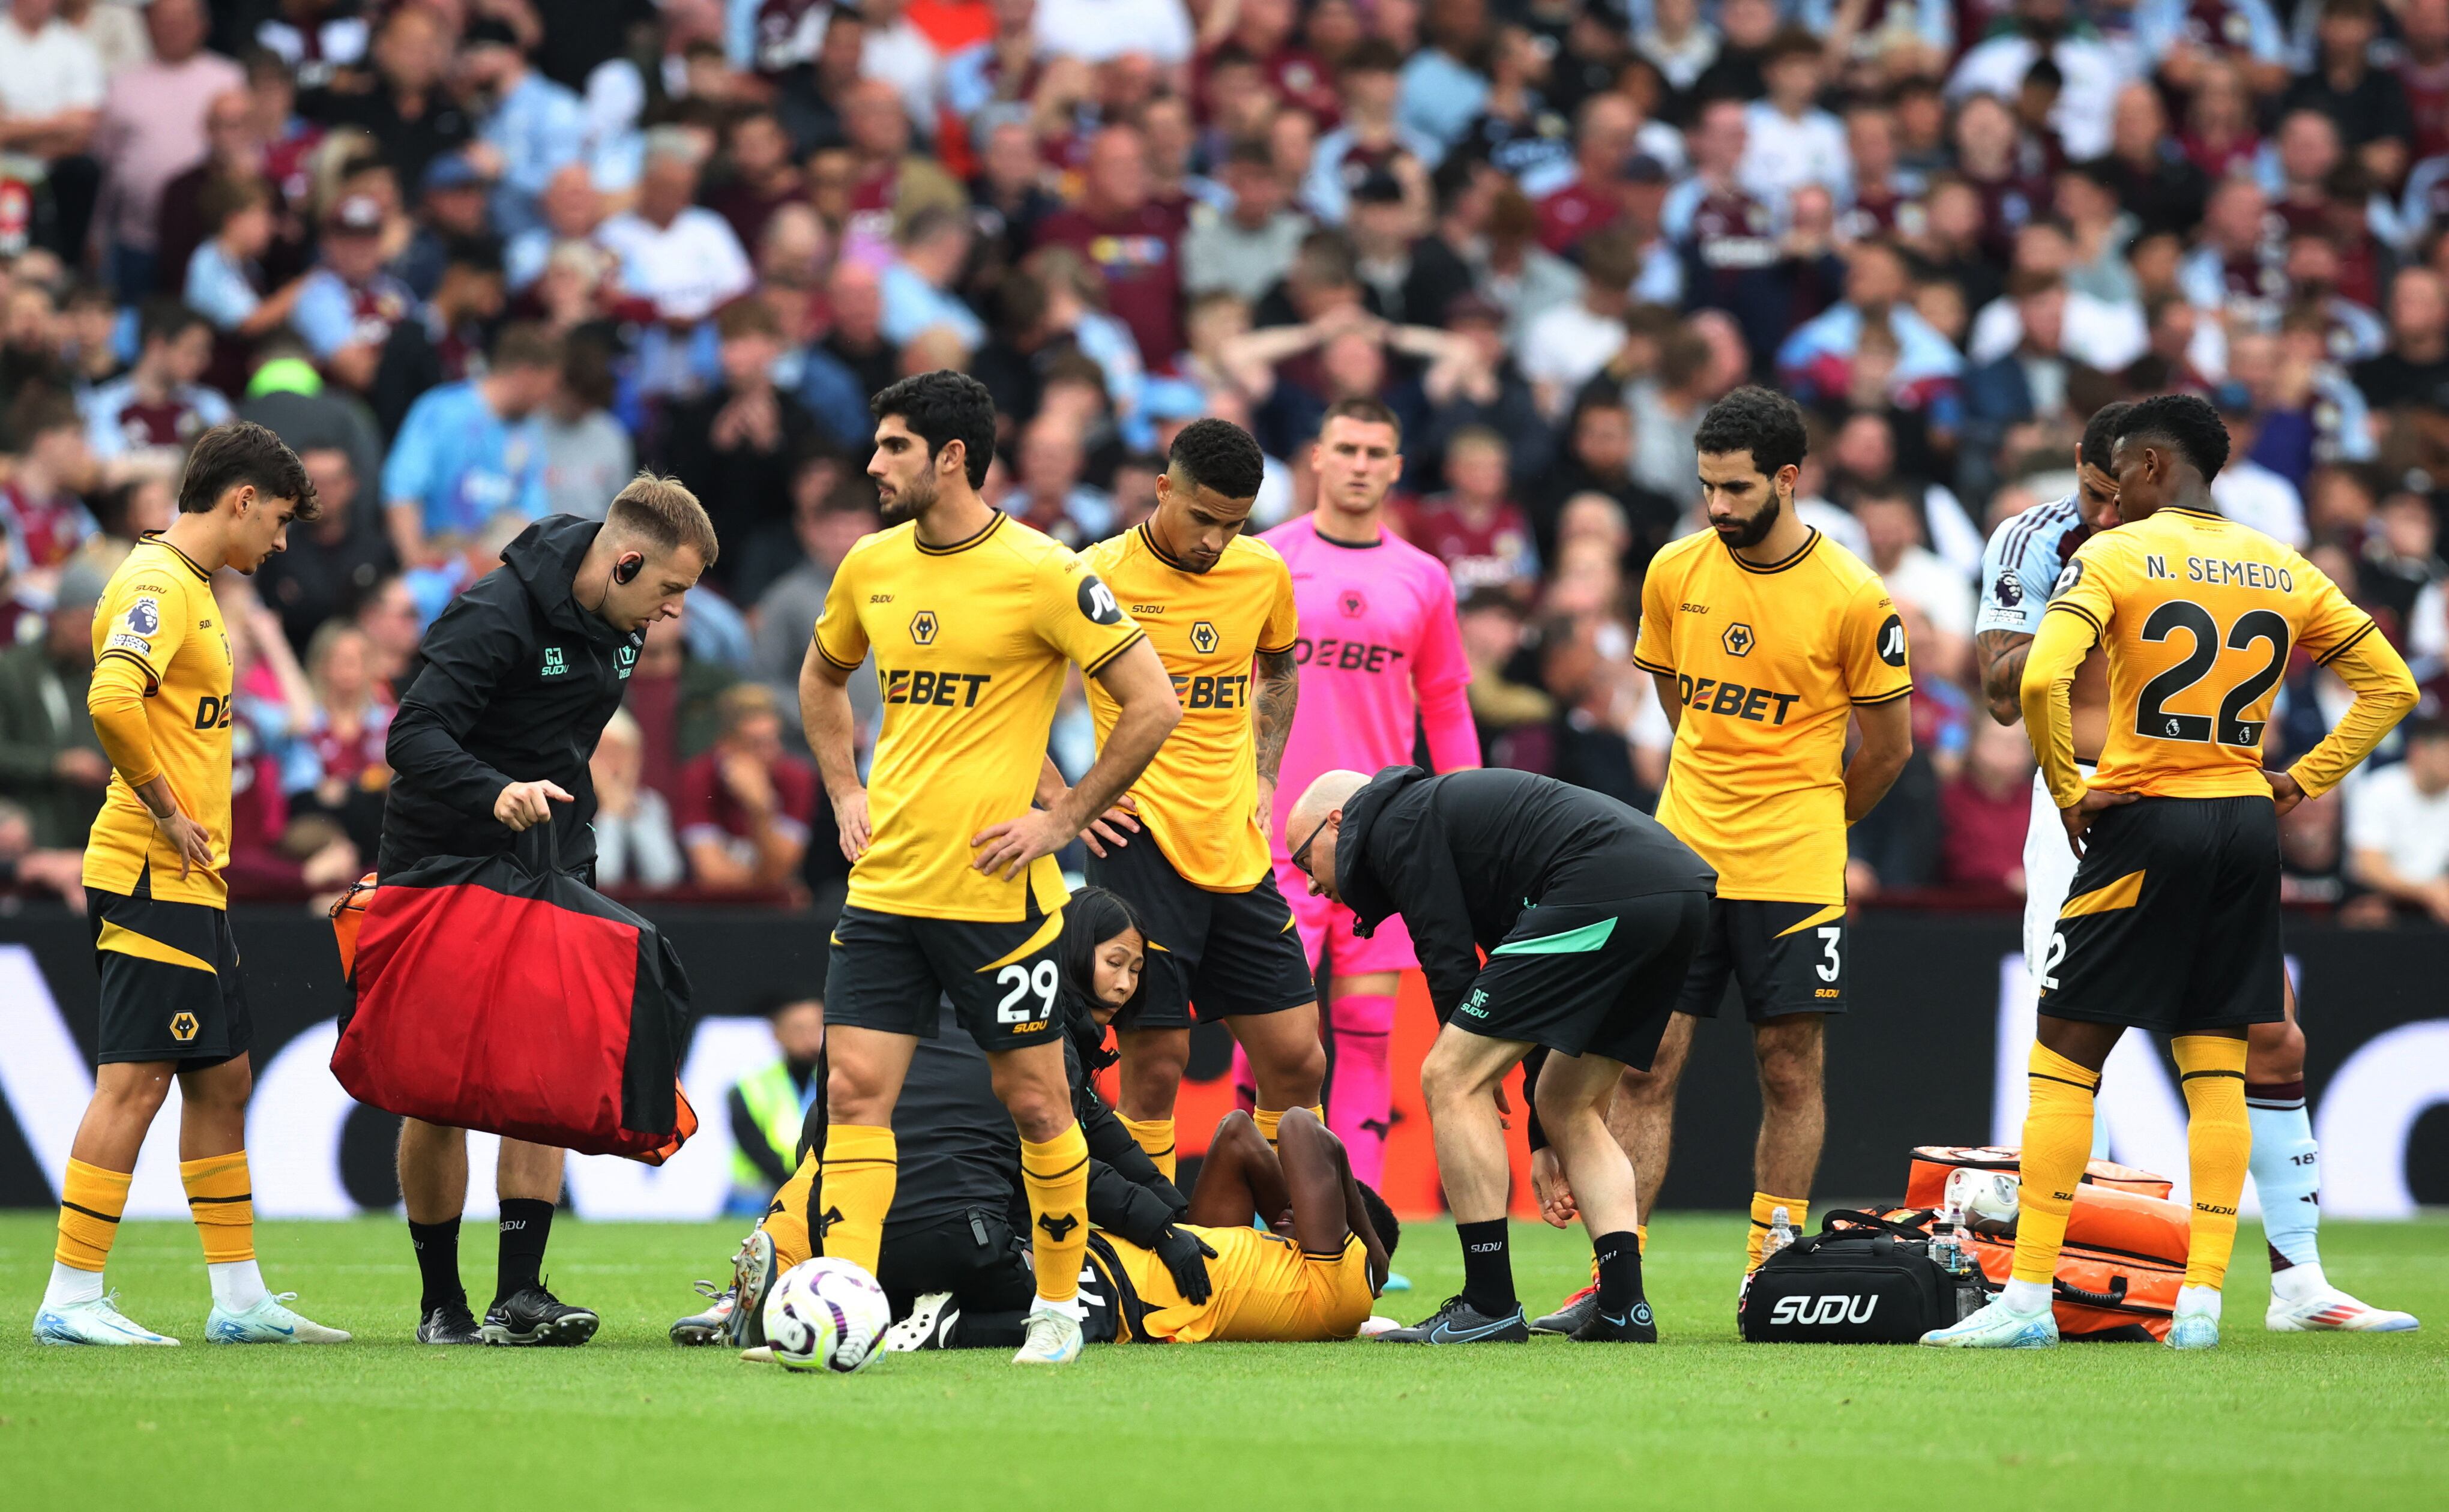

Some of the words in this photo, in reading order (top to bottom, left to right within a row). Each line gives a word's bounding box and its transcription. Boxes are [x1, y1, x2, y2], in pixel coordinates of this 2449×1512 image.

[2146, 555, 2176, 579] N.
[2187, 556, 2293, 593] SEMEDO
[134, 584, 167, 595] SUDU
[869, 594, 895, 603] SUDU
[1089, 582, 1116, 621] JD
[1131, 604, 1165, 613] SUDU
[1679, 603, 1709, 614] SUDU
[126, 635, 149, 651] room
[545, 647, 564, 666] GJ
[541, 664, 570, 676] SUDU
[2135, 600, 2290, 748] 22
[1679, 673, 1800, 725] DEBET
[1815, 926, 1842, 982] 3
[996, 959, 1058, 1023] 29
[1471, 988, 1489, 1008] RF
[1815, 988, 1840, 998] SUDU
[1460, 1002, 1490, 1019] SUDU
[1013, 1019, 1047, 1034] SUDU
[2289, 1152, 2318, 1166] 18
[2196, 1202, 2237, 1215] SUDU
[1471, 1241, 1502, 1254] SUDU
[1770, 1294, 1879, 1325] SUDU
